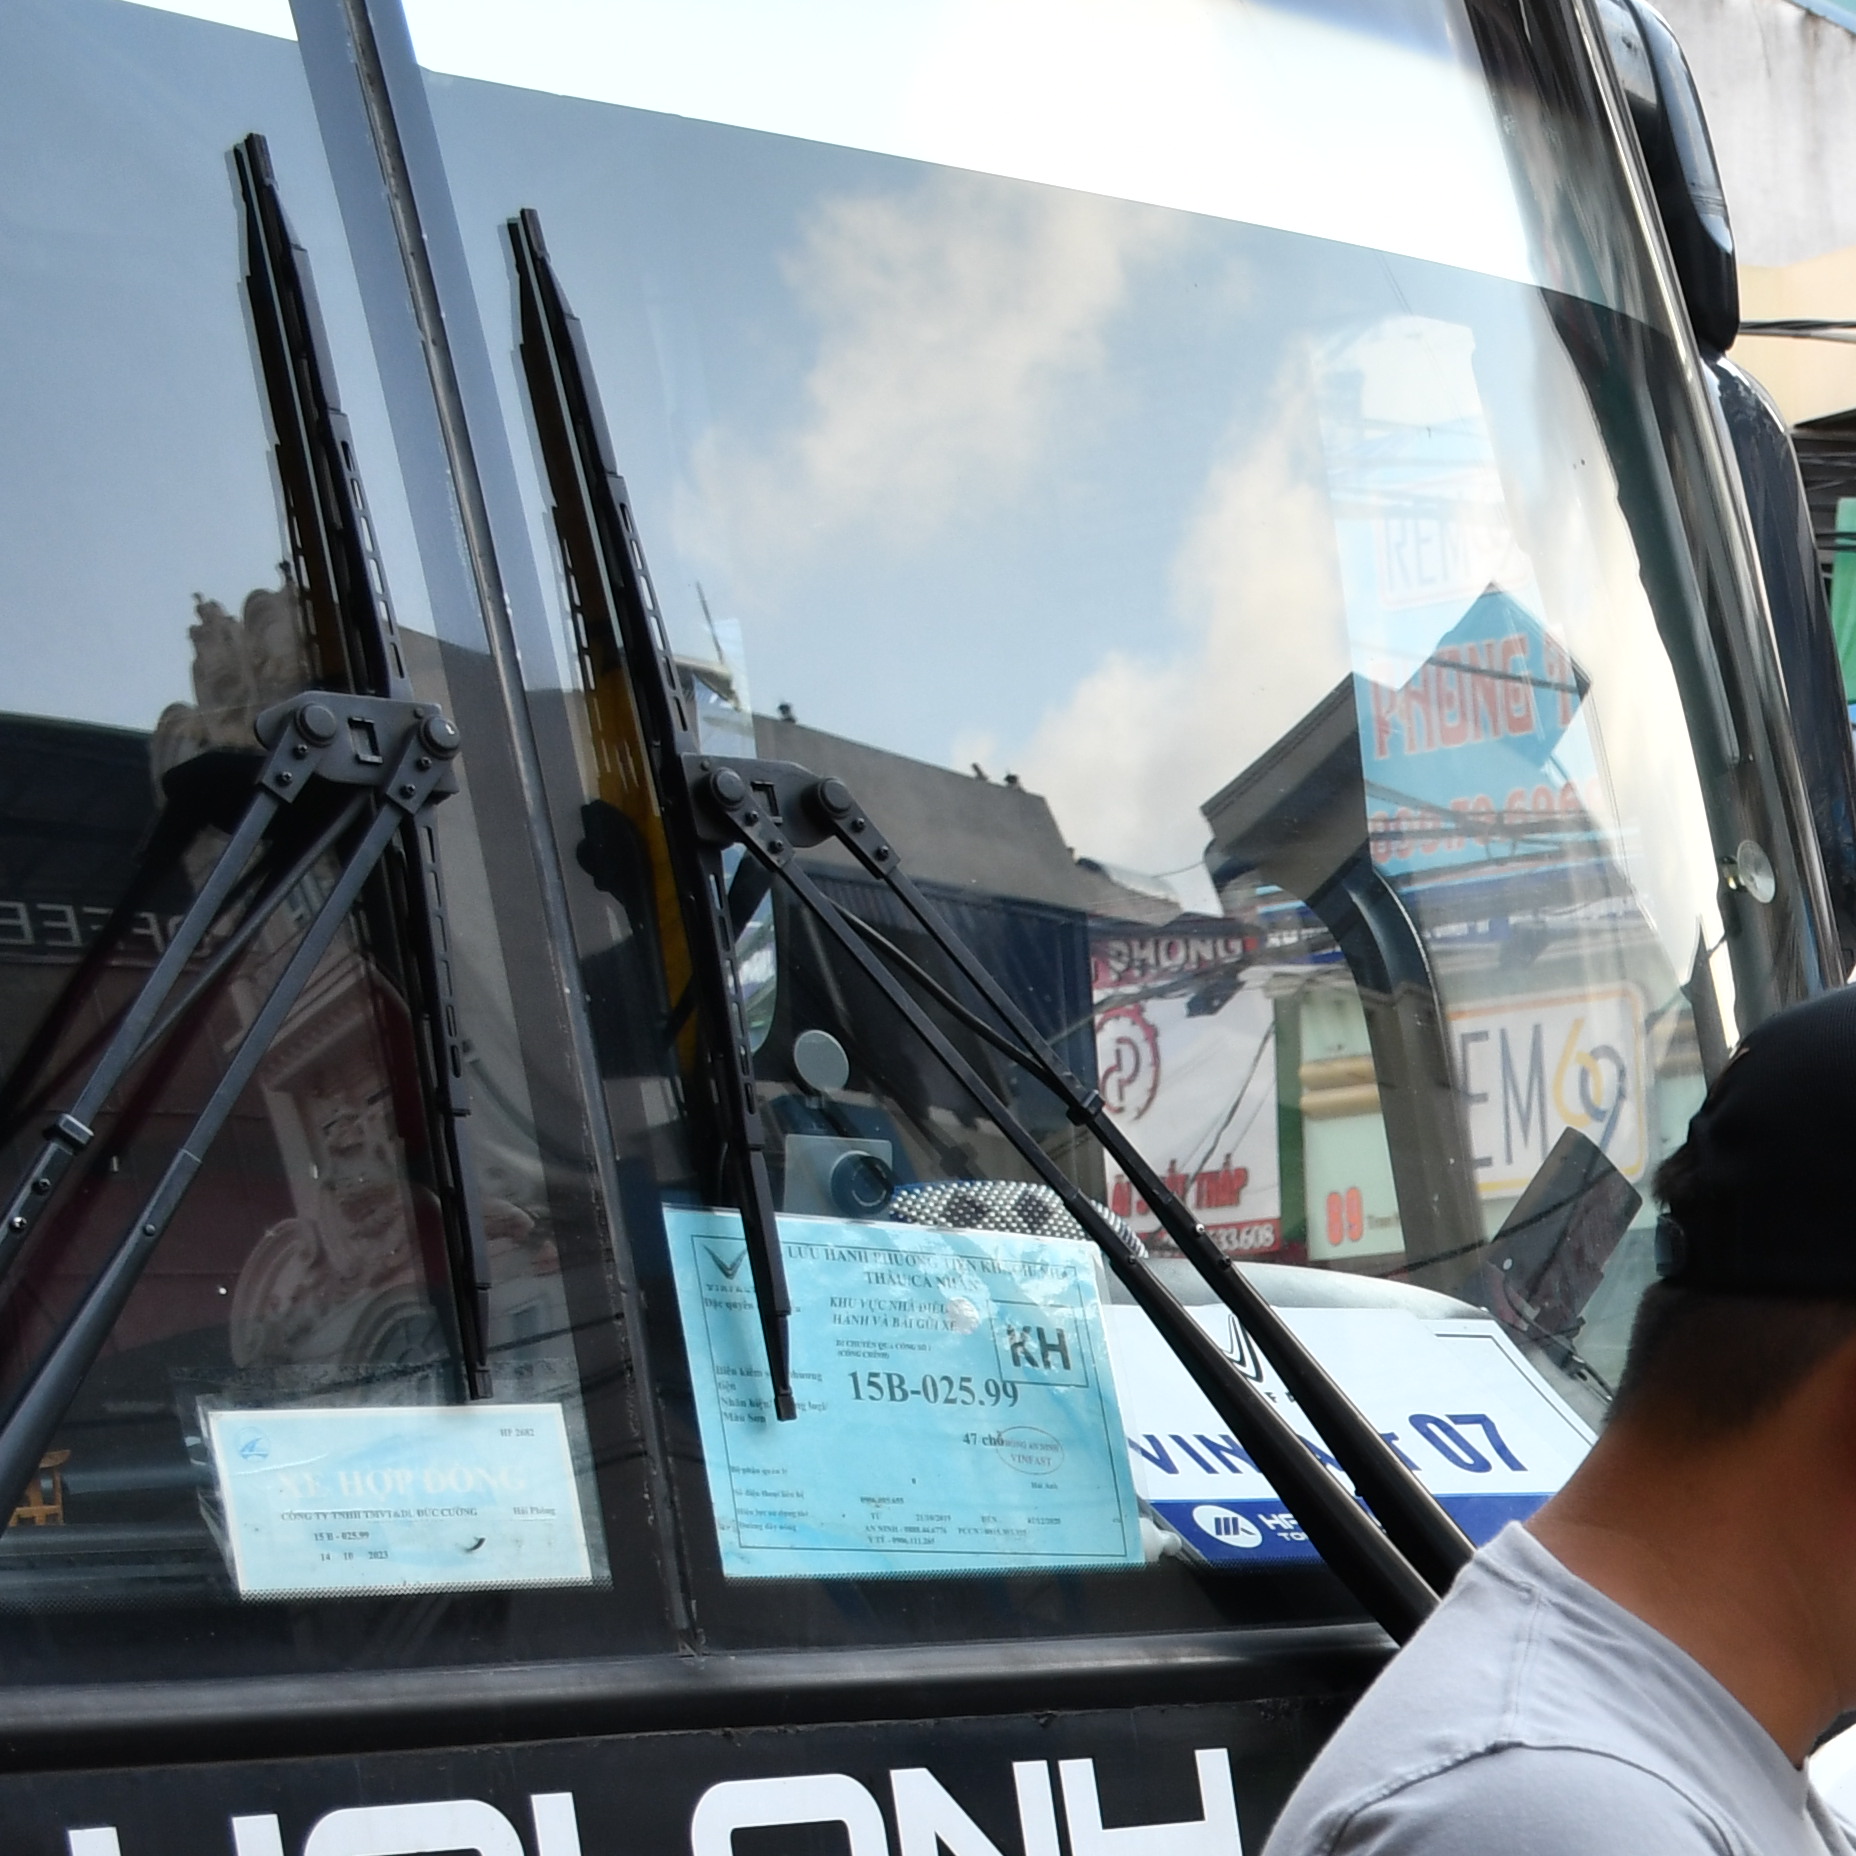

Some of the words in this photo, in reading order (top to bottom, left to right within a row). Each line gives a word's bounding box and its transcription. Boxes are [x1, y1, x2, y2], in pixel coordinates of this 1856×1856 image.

[1005, 1324, 1072, 1370] KH
[848, 1369, 1020, 1408] 15B-025.99
[1408, 1412, 1529, 1474] 07
